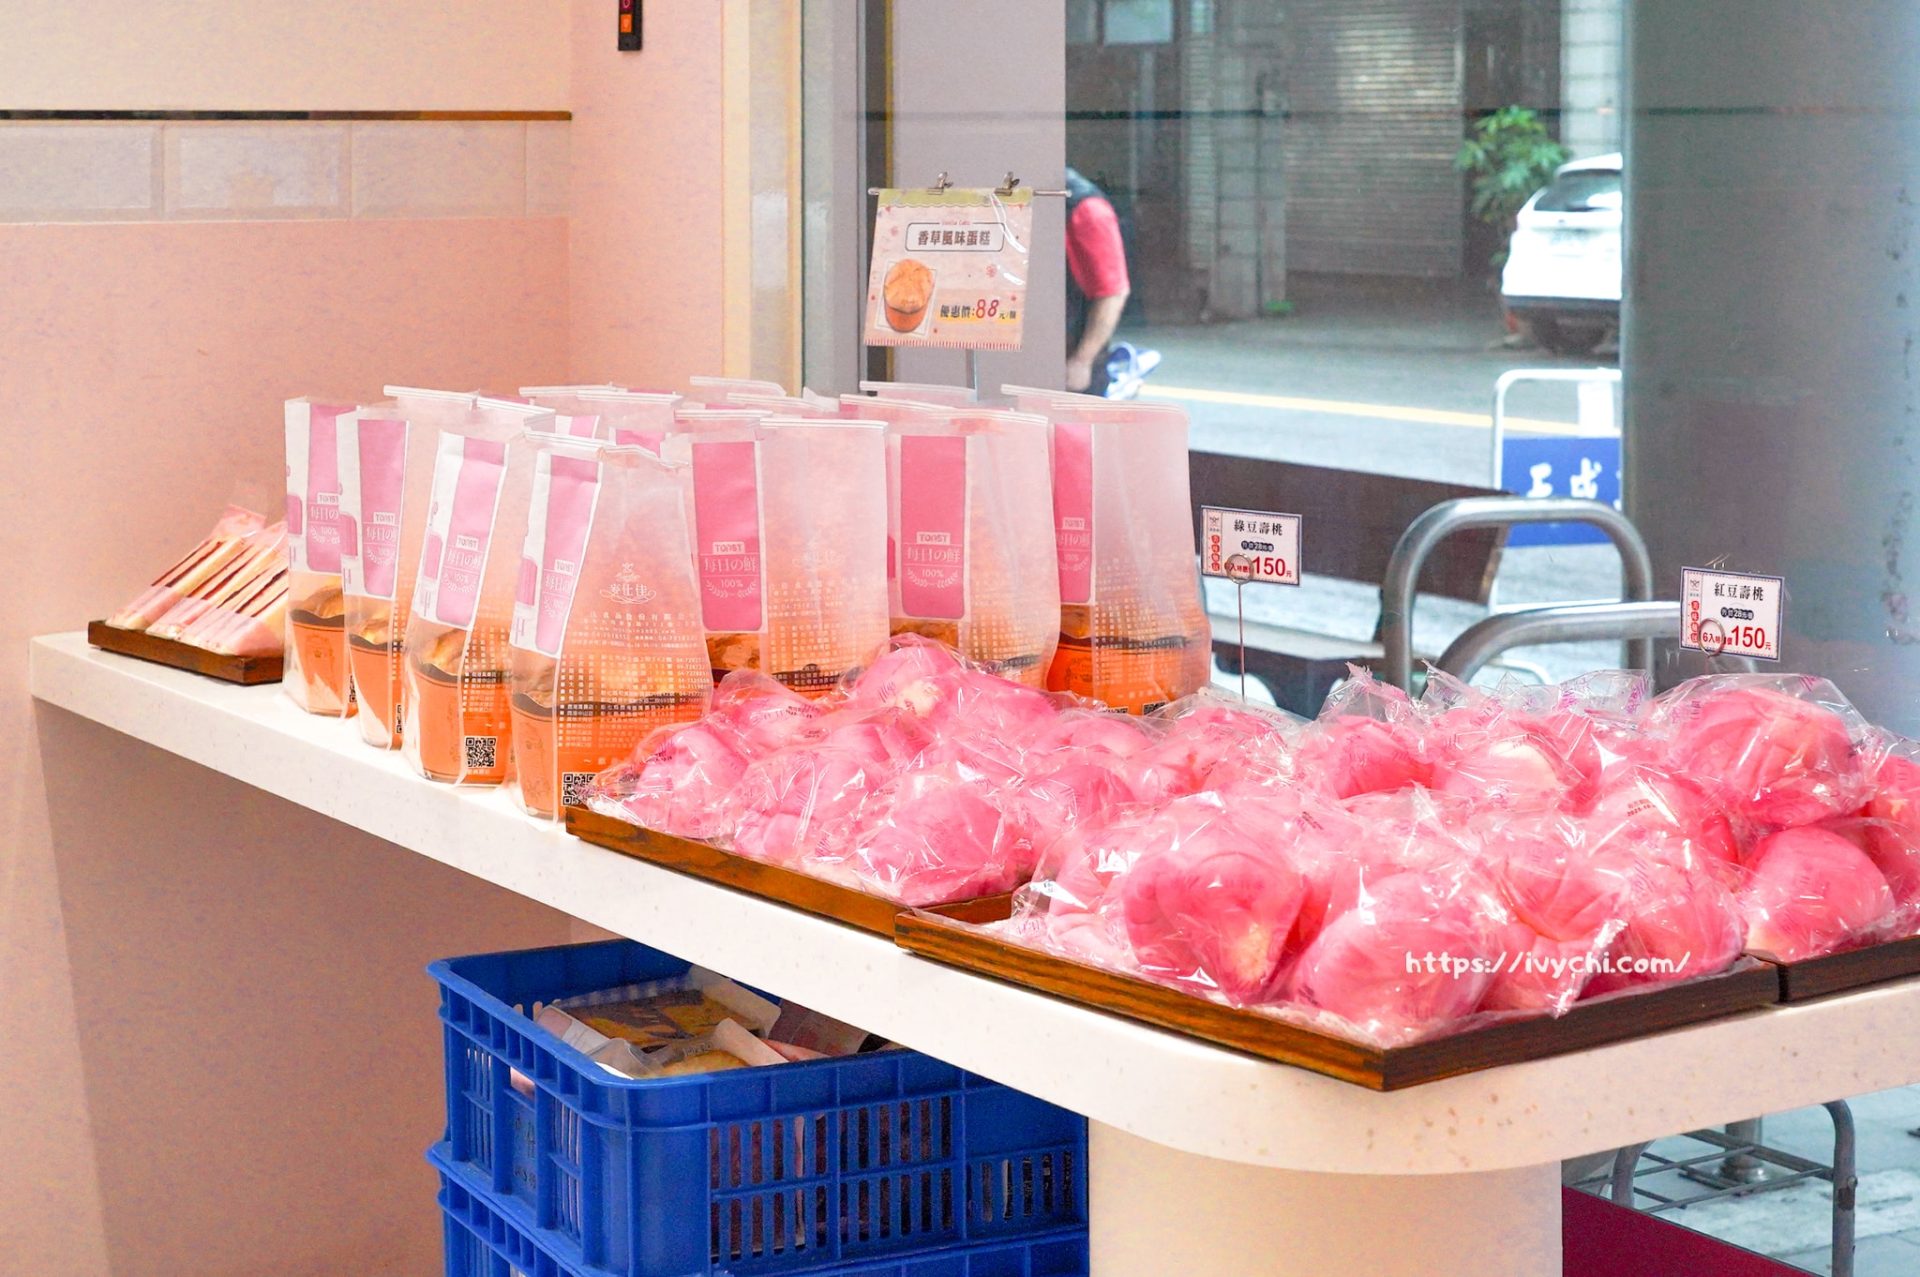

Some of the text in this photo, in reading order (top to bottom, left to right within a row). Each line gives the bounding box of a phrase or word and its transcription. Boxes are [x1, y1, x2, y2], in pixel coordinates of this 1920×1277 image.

[918, 230, 991, 246] 香草風味蛋糕
[919, 534, 947, 544] TOAST
[714, 544, 743, 553] TOAST
[1714, 582, 1764, 601] 紅豆壽桃
